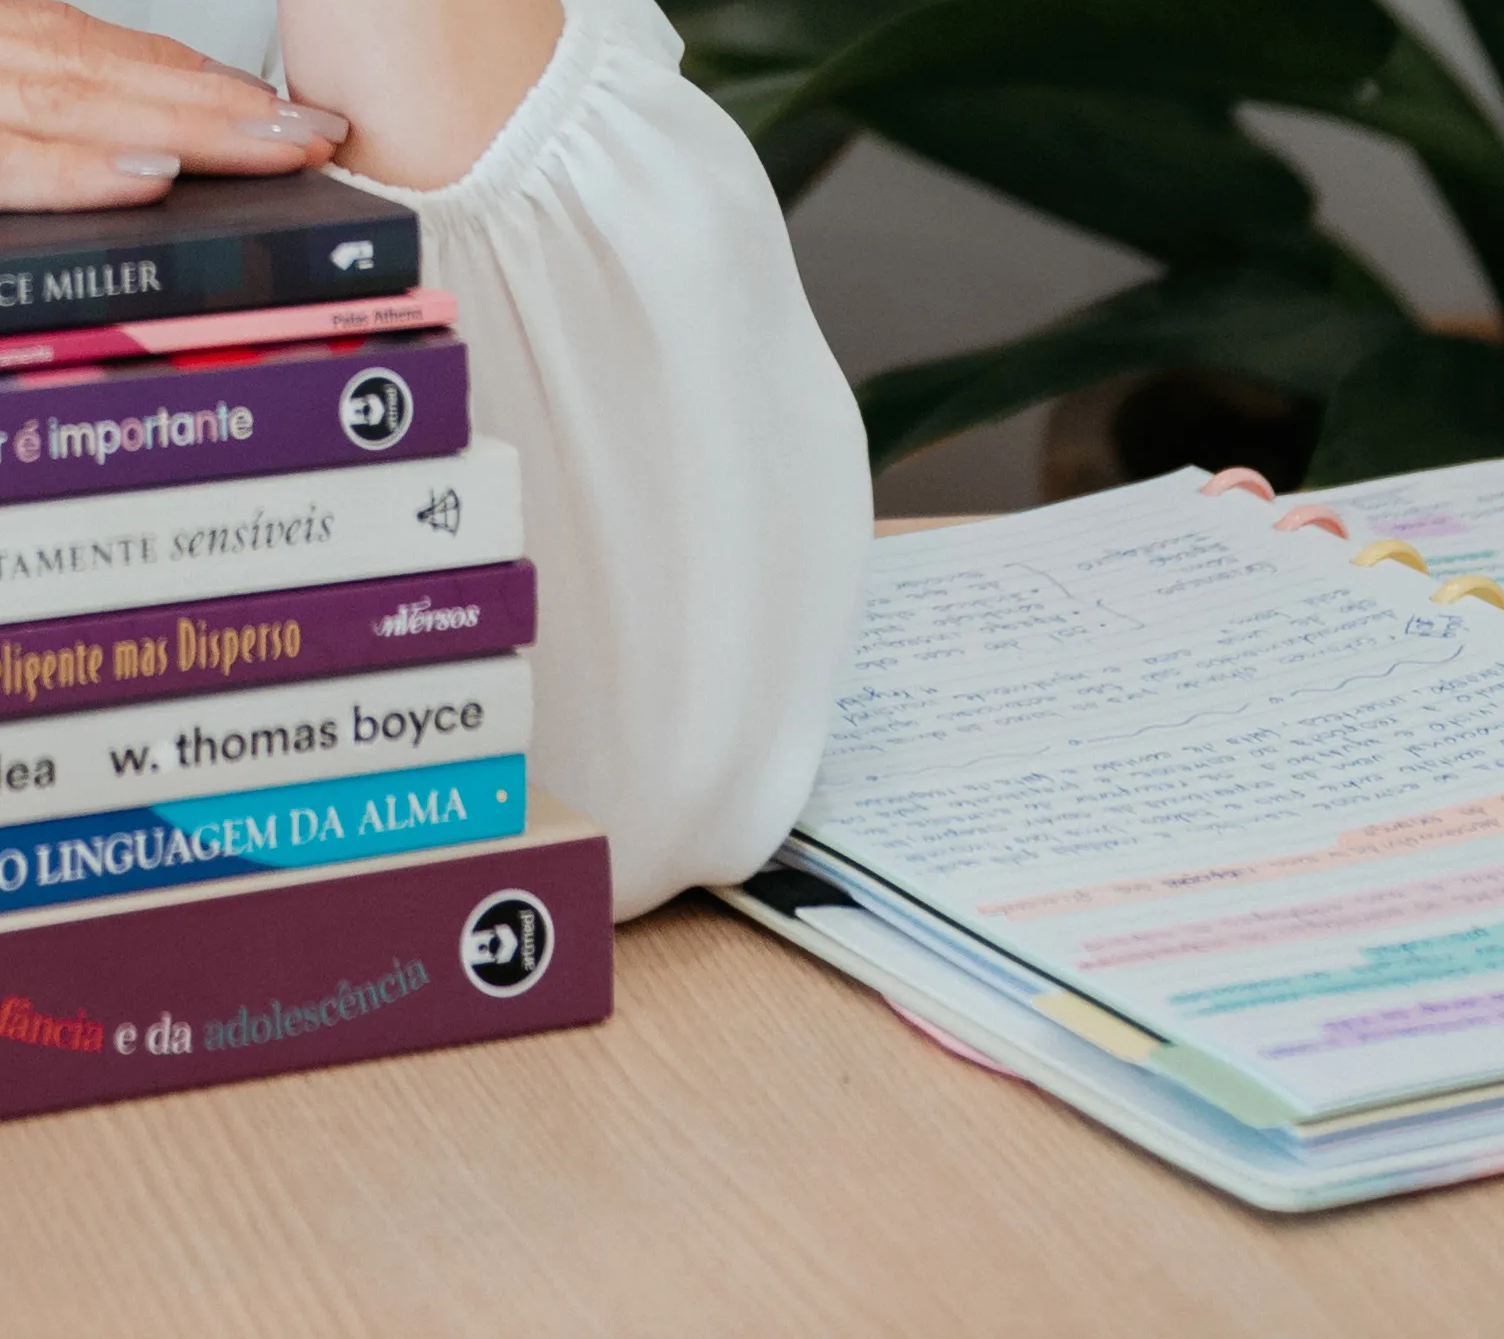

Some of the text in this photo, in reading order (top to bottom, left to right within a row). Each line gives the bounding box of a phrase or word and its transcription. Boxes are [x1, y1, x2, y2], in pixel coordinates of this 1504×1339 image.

[42, 260, 161, 303] MILLER
[15, 419, 41, 463] é
[48, 400, 253, 464] importante
[170, 503, 335, 562] sensíveis
[113, 638, 168, 678] mas
[177, 617, 301, 675] Disperso
[110, 699, 484, 779] w. thomas boyce
[37, 815, 277, 887] LINGUAGEM
[290, 807, 346, 846] DA
[357, 787, 468, 834] ALMA
[517, 909, 536, 972] artmed
[113, 1023, 137, 1055] e
[146, 1010, 193, 1055] da
[204, 957, 431, 1051] adolescência
